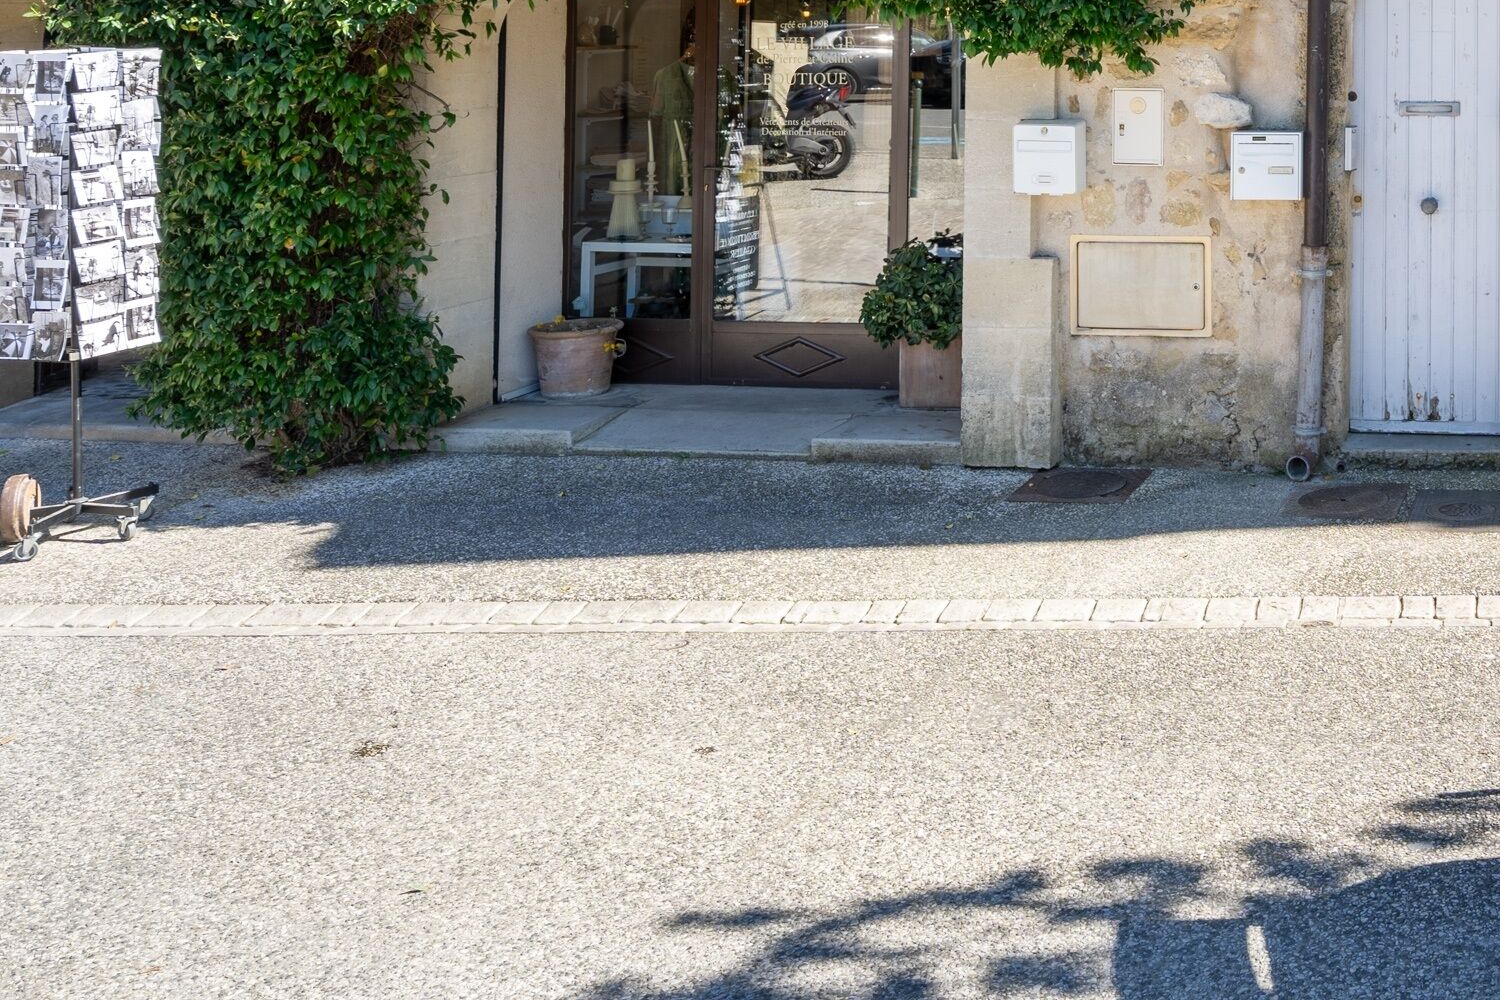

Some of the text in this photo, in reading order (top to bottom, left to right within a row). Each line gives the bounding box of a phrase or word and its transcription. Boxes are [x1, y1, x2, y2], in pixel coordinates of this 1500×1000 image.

[780, 21, 796, 29] créé
[809, 20, 829, 29] 1998
[756, 54, 769, 64] de
[763, 72, 848, 88] BOUTIQUE
[801, 117, 810, 126] de
[806, 127, 847, 136] d'Intérieur
